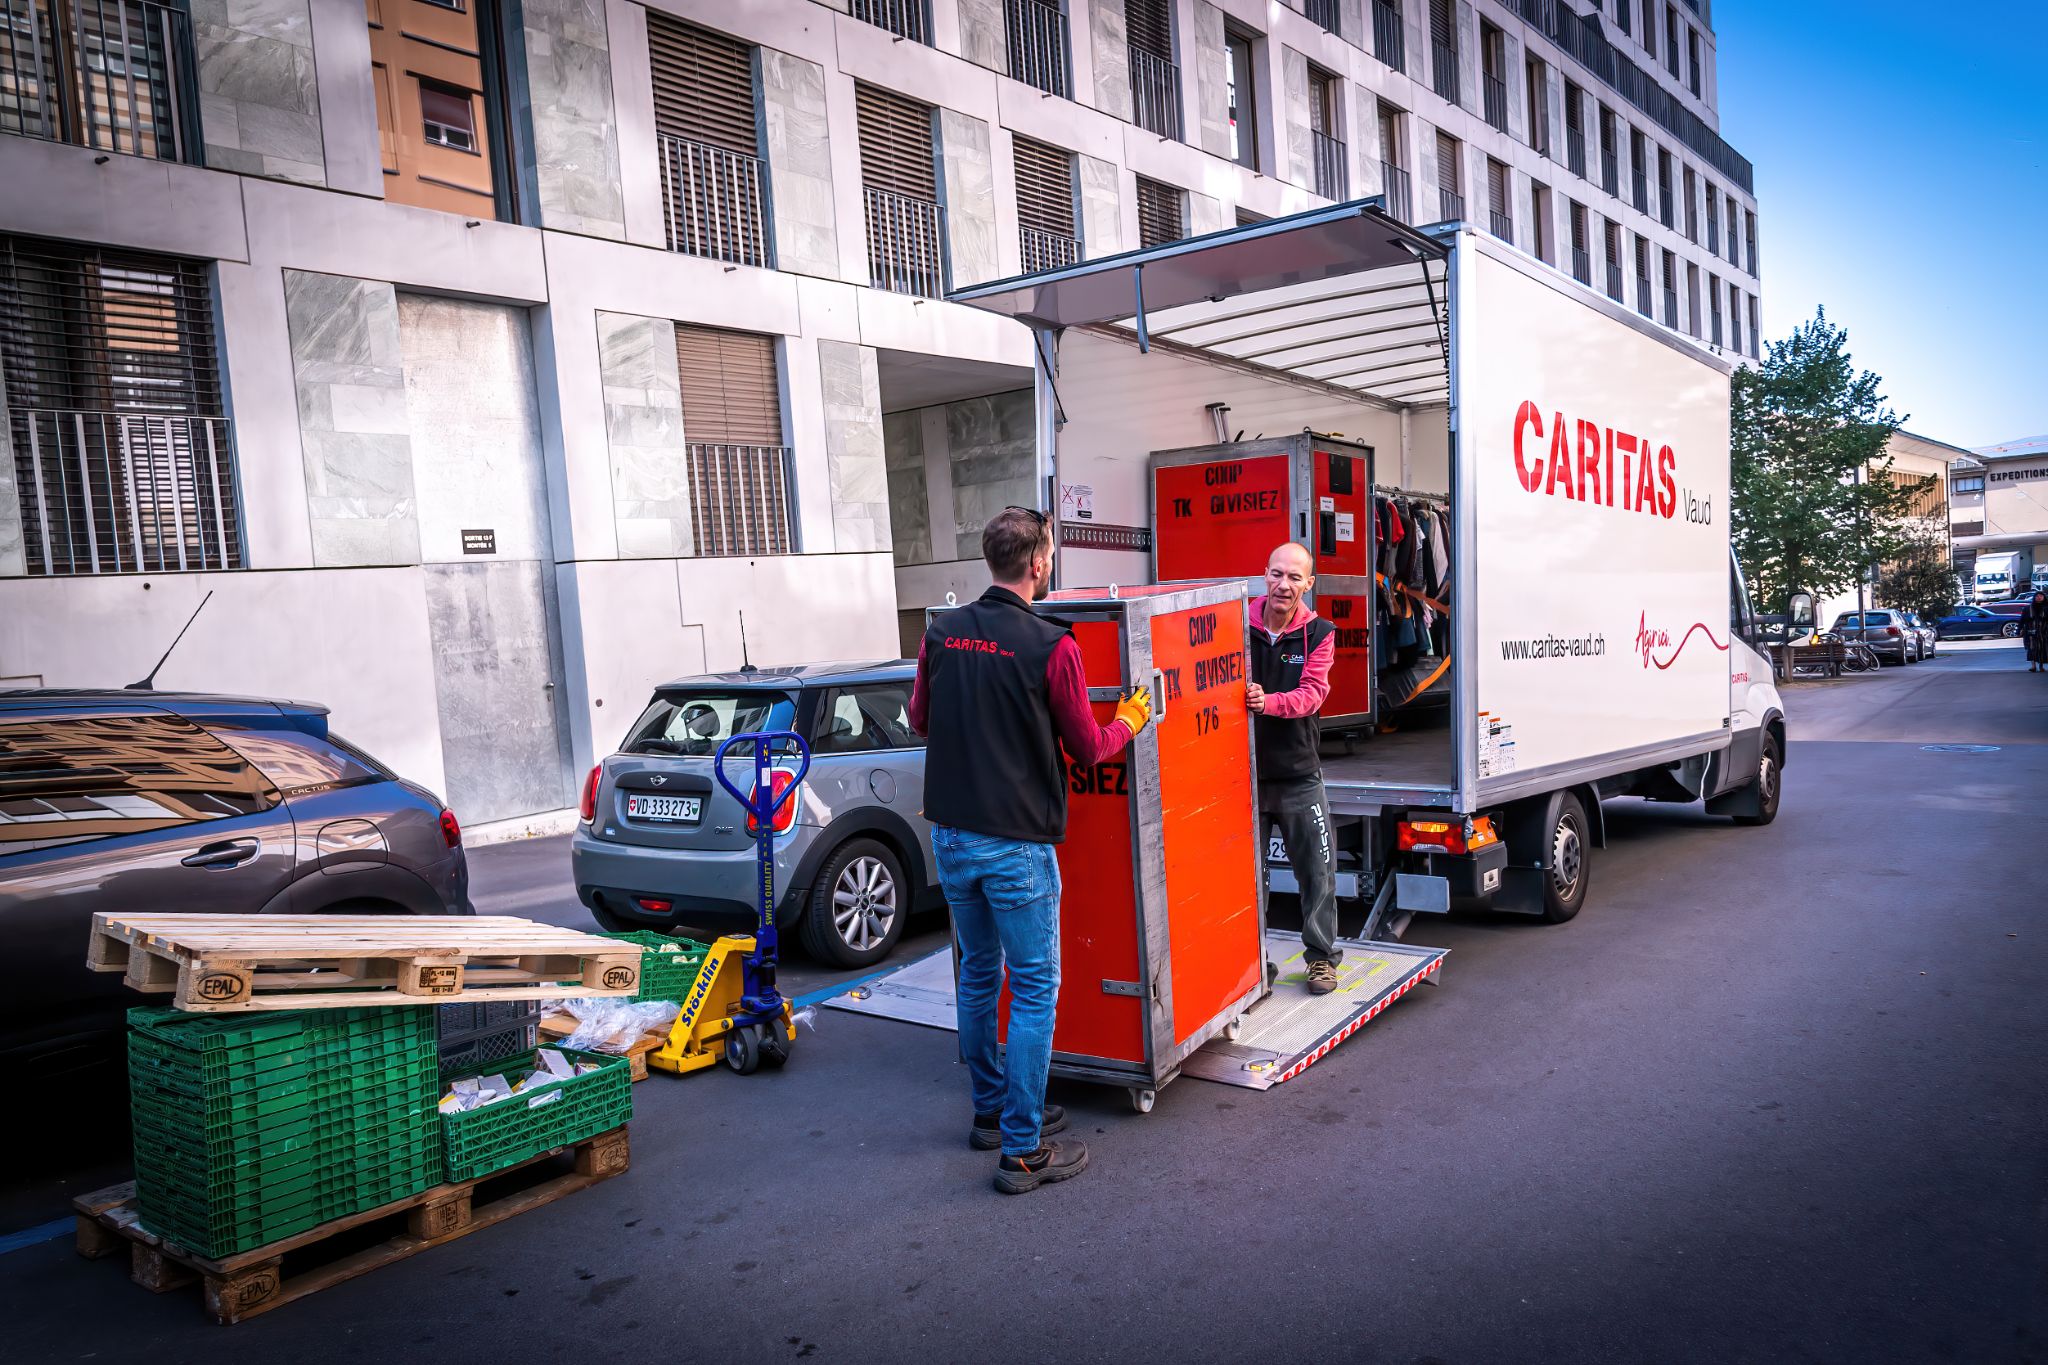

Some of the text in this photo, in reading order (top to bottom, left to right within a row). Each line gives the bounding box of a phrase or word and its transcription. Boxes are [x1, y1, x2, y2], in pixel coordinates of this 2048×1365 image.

[1205, 464, 1243, 486] COOP
[1513, 400, 1711, 526] CARITAS Vaud
[1172, 498, 1193, 518] TK
[1189, 613, 1217, 647] COOP
[1635, 609, 1658, 669] Agir
[944, 636, 998, 654] CARITAS
[1501, 633, 1605, 661] www.caritas-vaud.ch
[1165, 667, 1182, 700] TK
[1195, 705, 1219, 736] 176
[291, 785, 331, 795] CACTUS
[1070, 761, 1129, 795] SIEZ
[764, 861, 773, 926] SWISS QUALITY
[203, 979, 236, 995] EPAL
[607, 971, 630, 984] EPAL
[682, 958, 719, 1027] Stöcklin
[240, 1281, 269, 1301] EPAL
